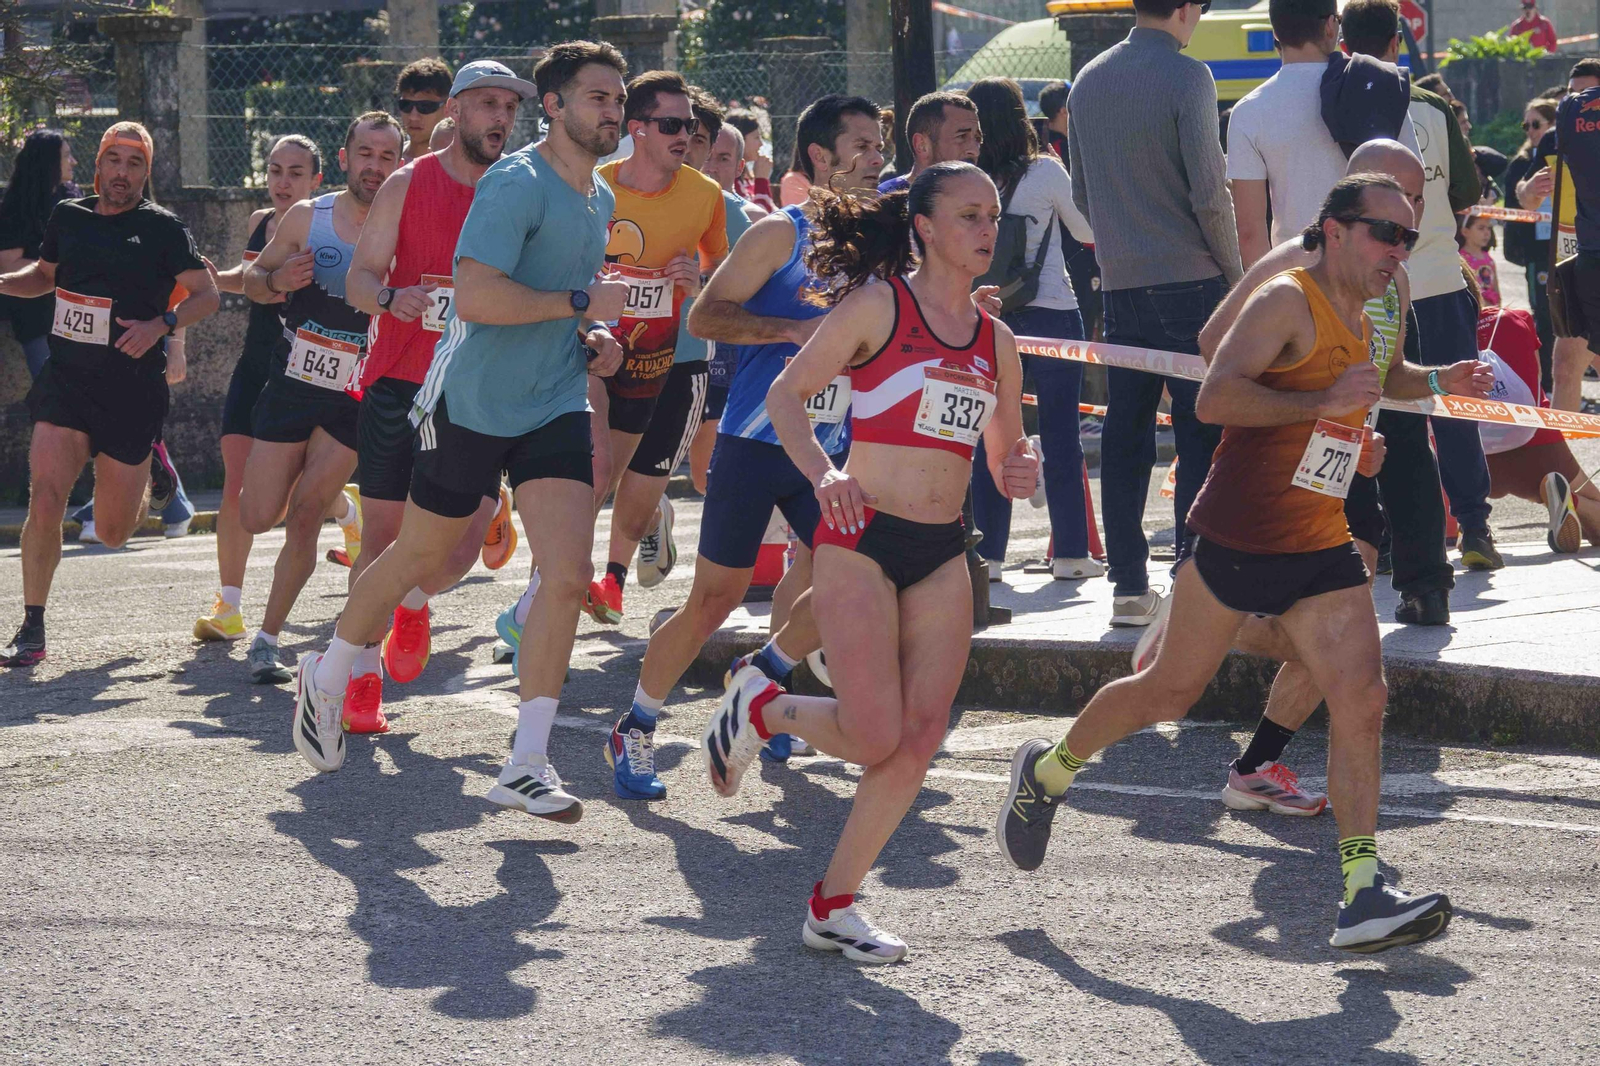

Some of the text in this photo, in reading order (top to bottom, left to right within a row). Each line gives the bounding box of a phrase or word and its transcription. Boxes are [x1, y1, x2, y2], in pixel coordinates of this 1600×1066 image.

[63, 308, 94, 335] 429
[302, 349, 341, 381] 643
[940, 392, 986, 432] 332
[1314, 447, 1352, 483] 273
